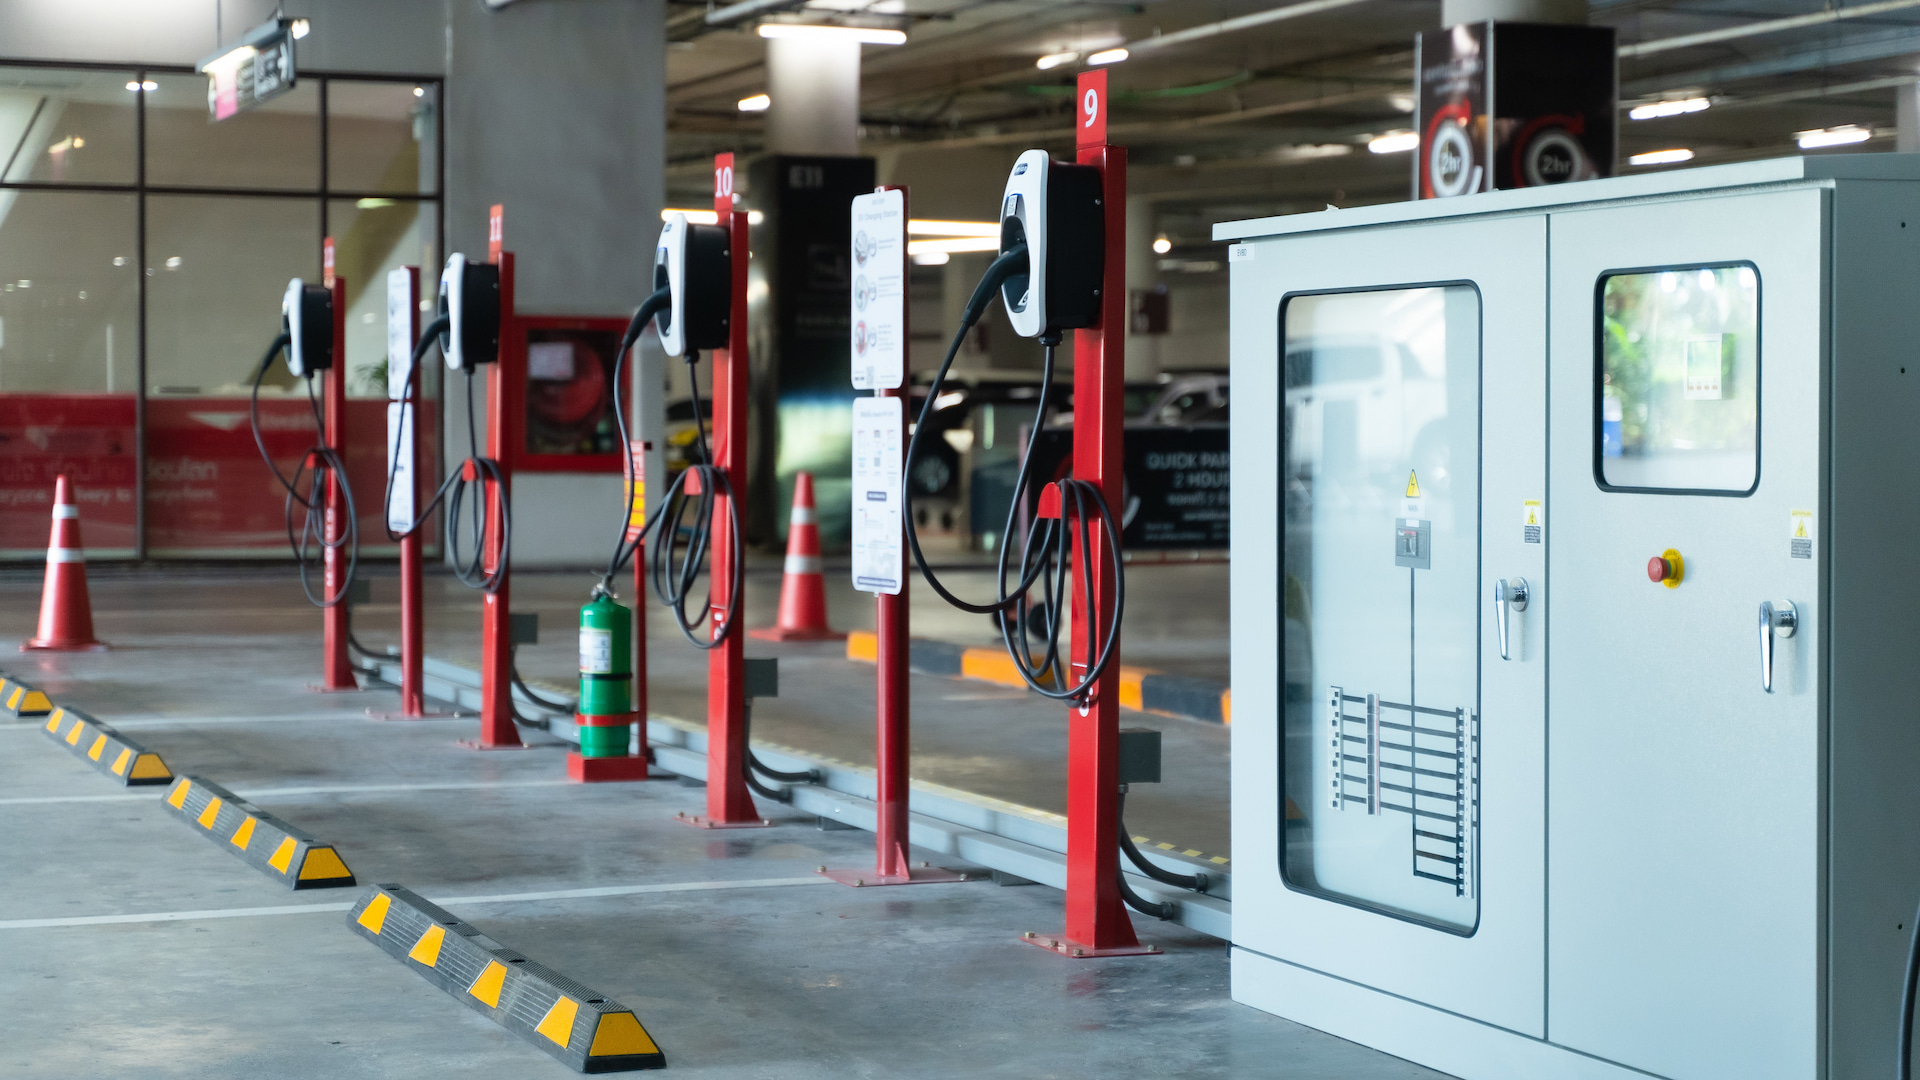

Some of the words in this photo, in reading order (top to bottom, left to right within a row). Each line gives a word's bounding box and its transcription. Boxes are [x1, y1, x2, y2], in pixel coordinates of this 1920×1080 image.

[1084, 88, 1098, 128] 9
[1440, 151, 1462, 173] 2hr
[1542, 156, 1572, 174] 2hr
[715, 166, 732, 198] 10
[490, 215, 503, 242] 11
[1147, 452, 1198, 470] QUICK
[1174, 472, 1184, 489] 2
